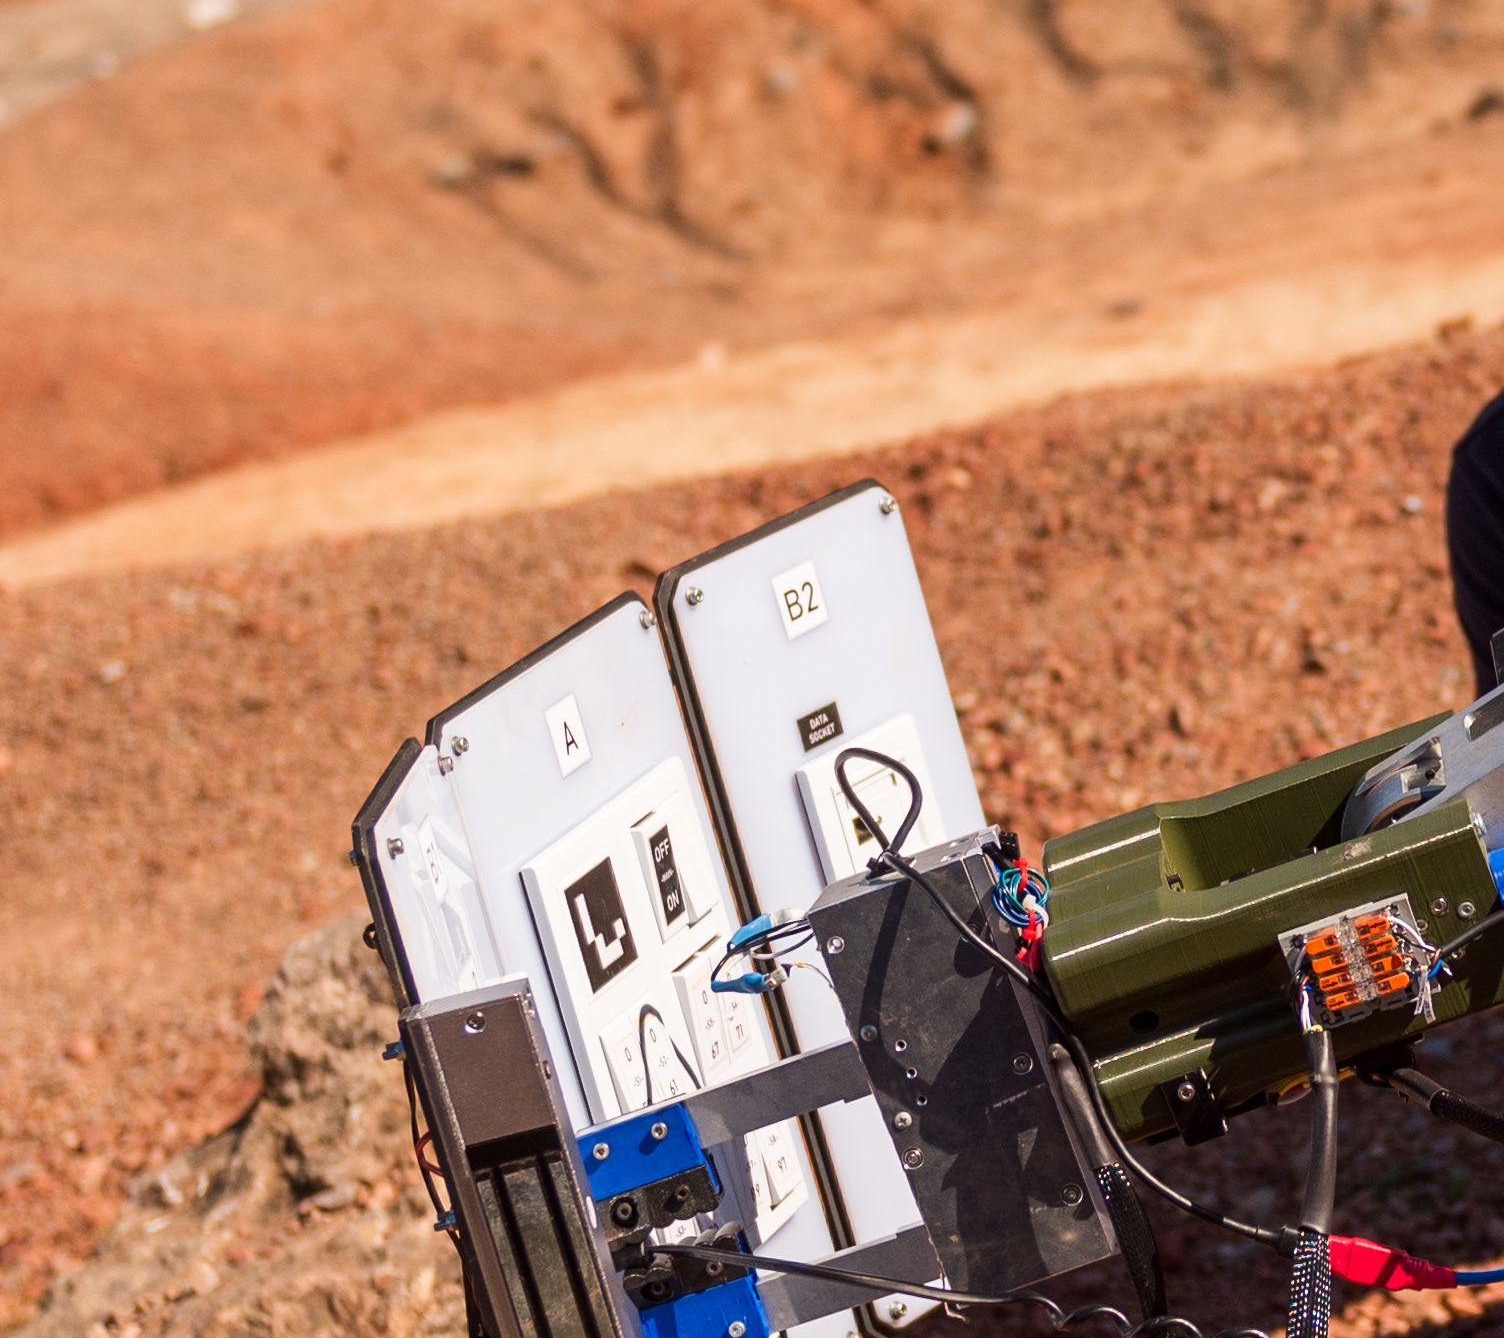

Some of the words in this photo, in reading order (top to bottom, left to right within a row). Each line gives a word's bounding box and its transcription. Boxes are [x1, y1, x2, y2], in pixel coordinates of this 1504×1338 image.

[783, 580, 820, 623] B2
[809, 713, 829, 730] DATA
[563, 720, 579, 756] A
[808, 721, 836, 745] SOCKET
[654, 837, 670, 863] OFF
[666, 888, 680, 911] ON
[702, 990, 708, 1005] 0
[649, 1028, 657, 1043] 0
[735, 1023, 744, 1040] 71
[624, 1047, 632, 1062] 0
[669, 1078, 679, 1095] 61
[777, 1156, 788, 1173] 97
